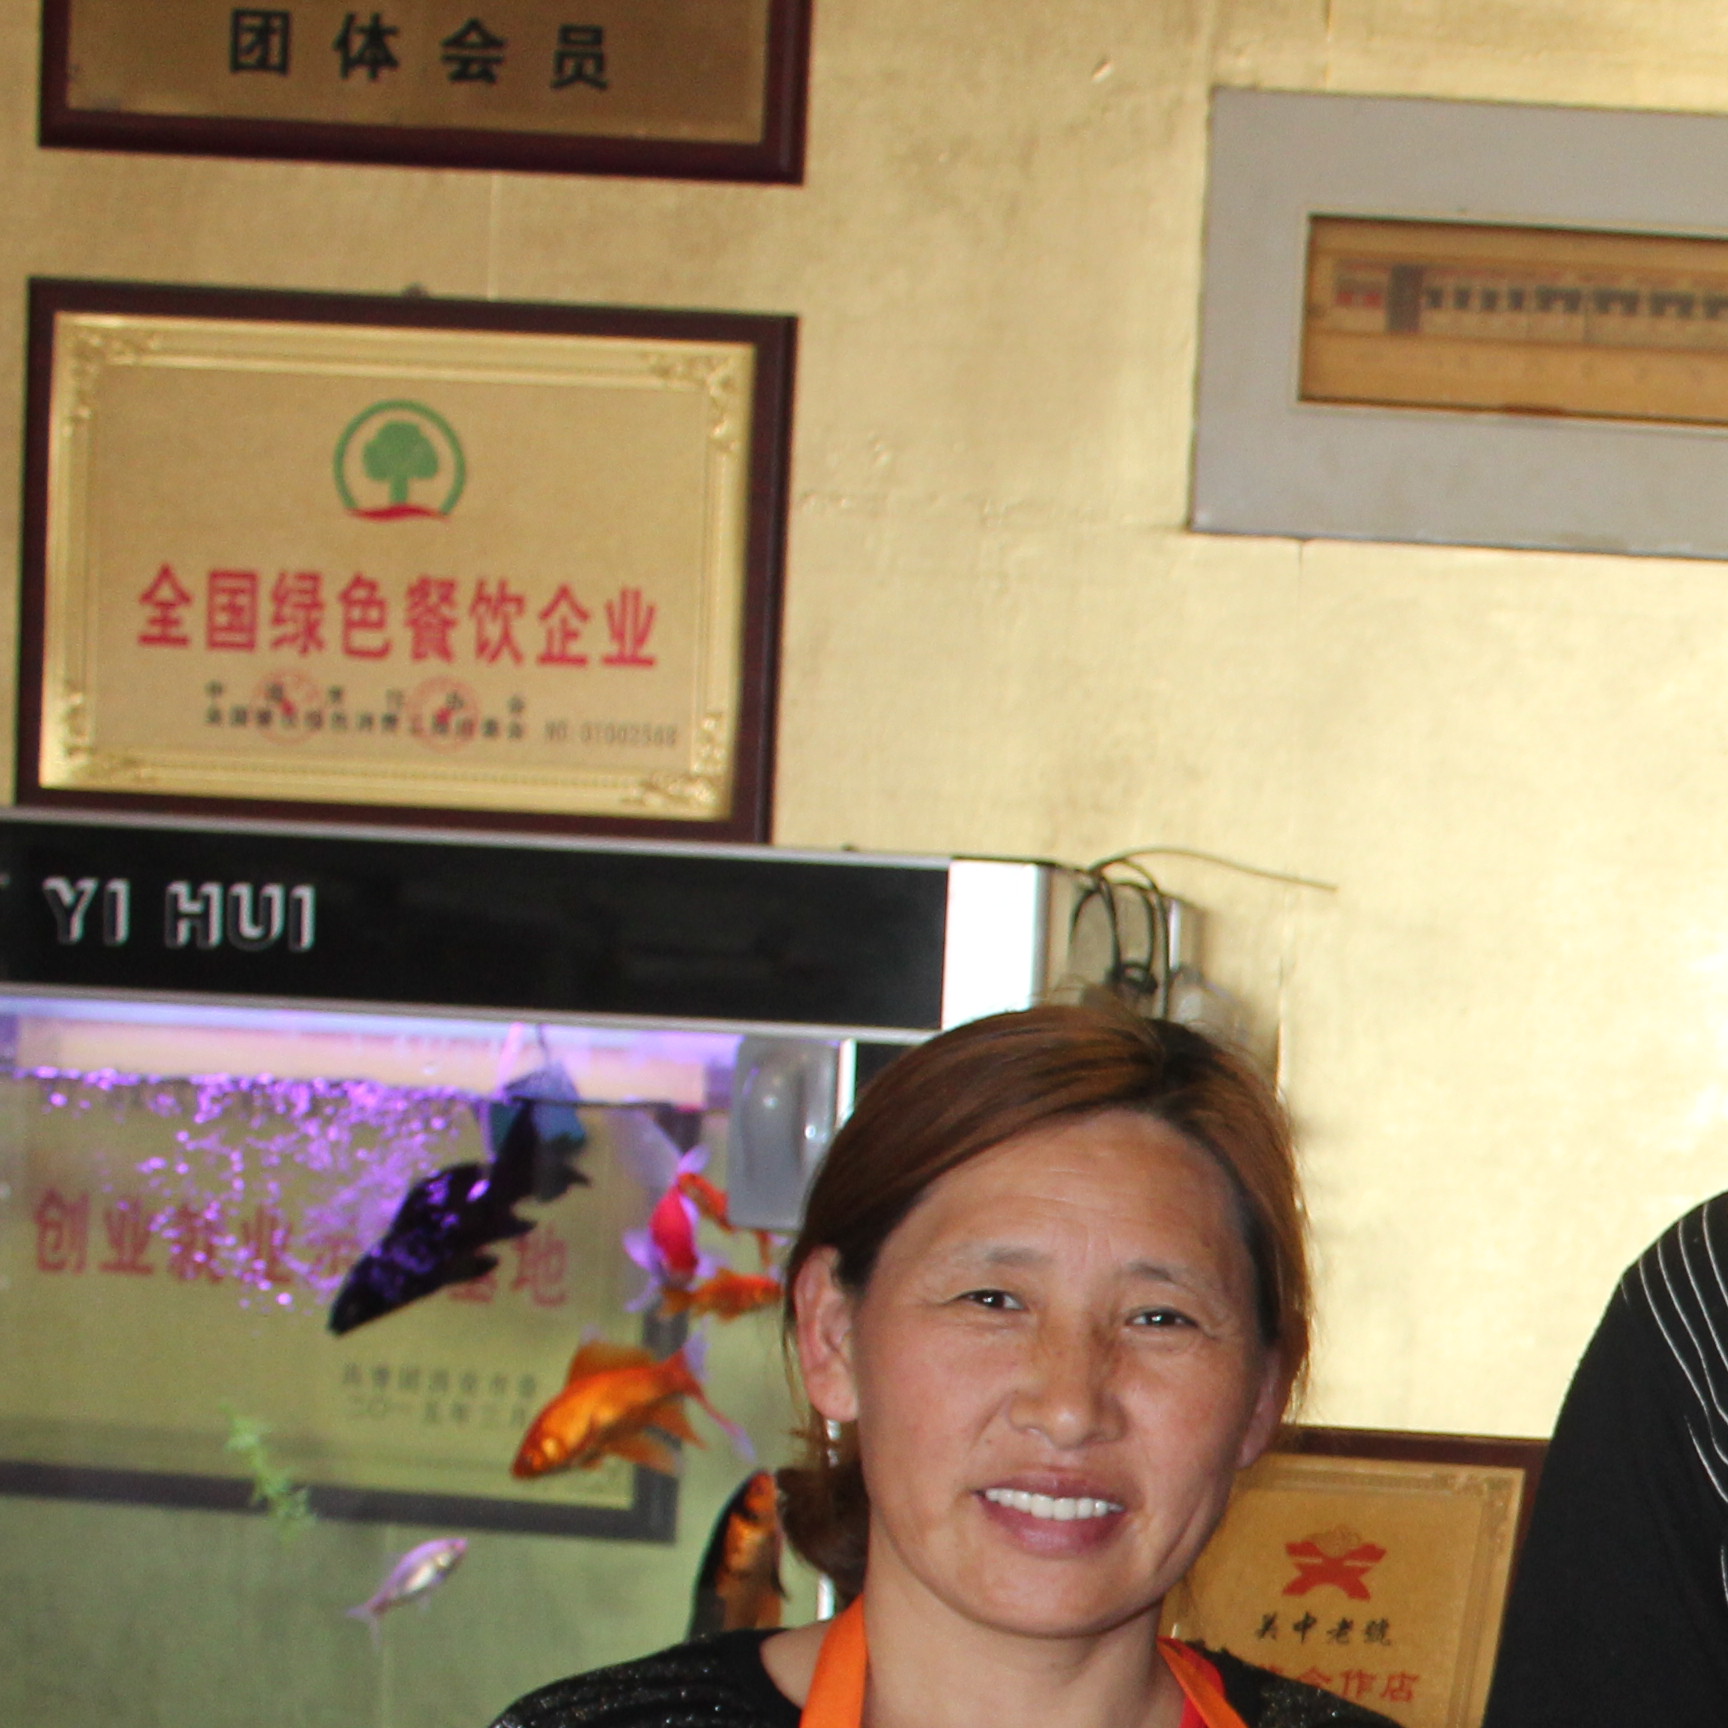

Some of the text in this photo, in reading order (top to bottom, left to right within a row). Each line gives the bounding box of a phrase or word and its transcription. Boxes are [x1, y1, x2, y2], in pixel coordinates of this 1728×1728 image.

[227, 8, 611, 91] 团体会员
[136, 562, 659, 671] 全国绿色餐饮企业
[41, 874, 316, 951] YI HUI
